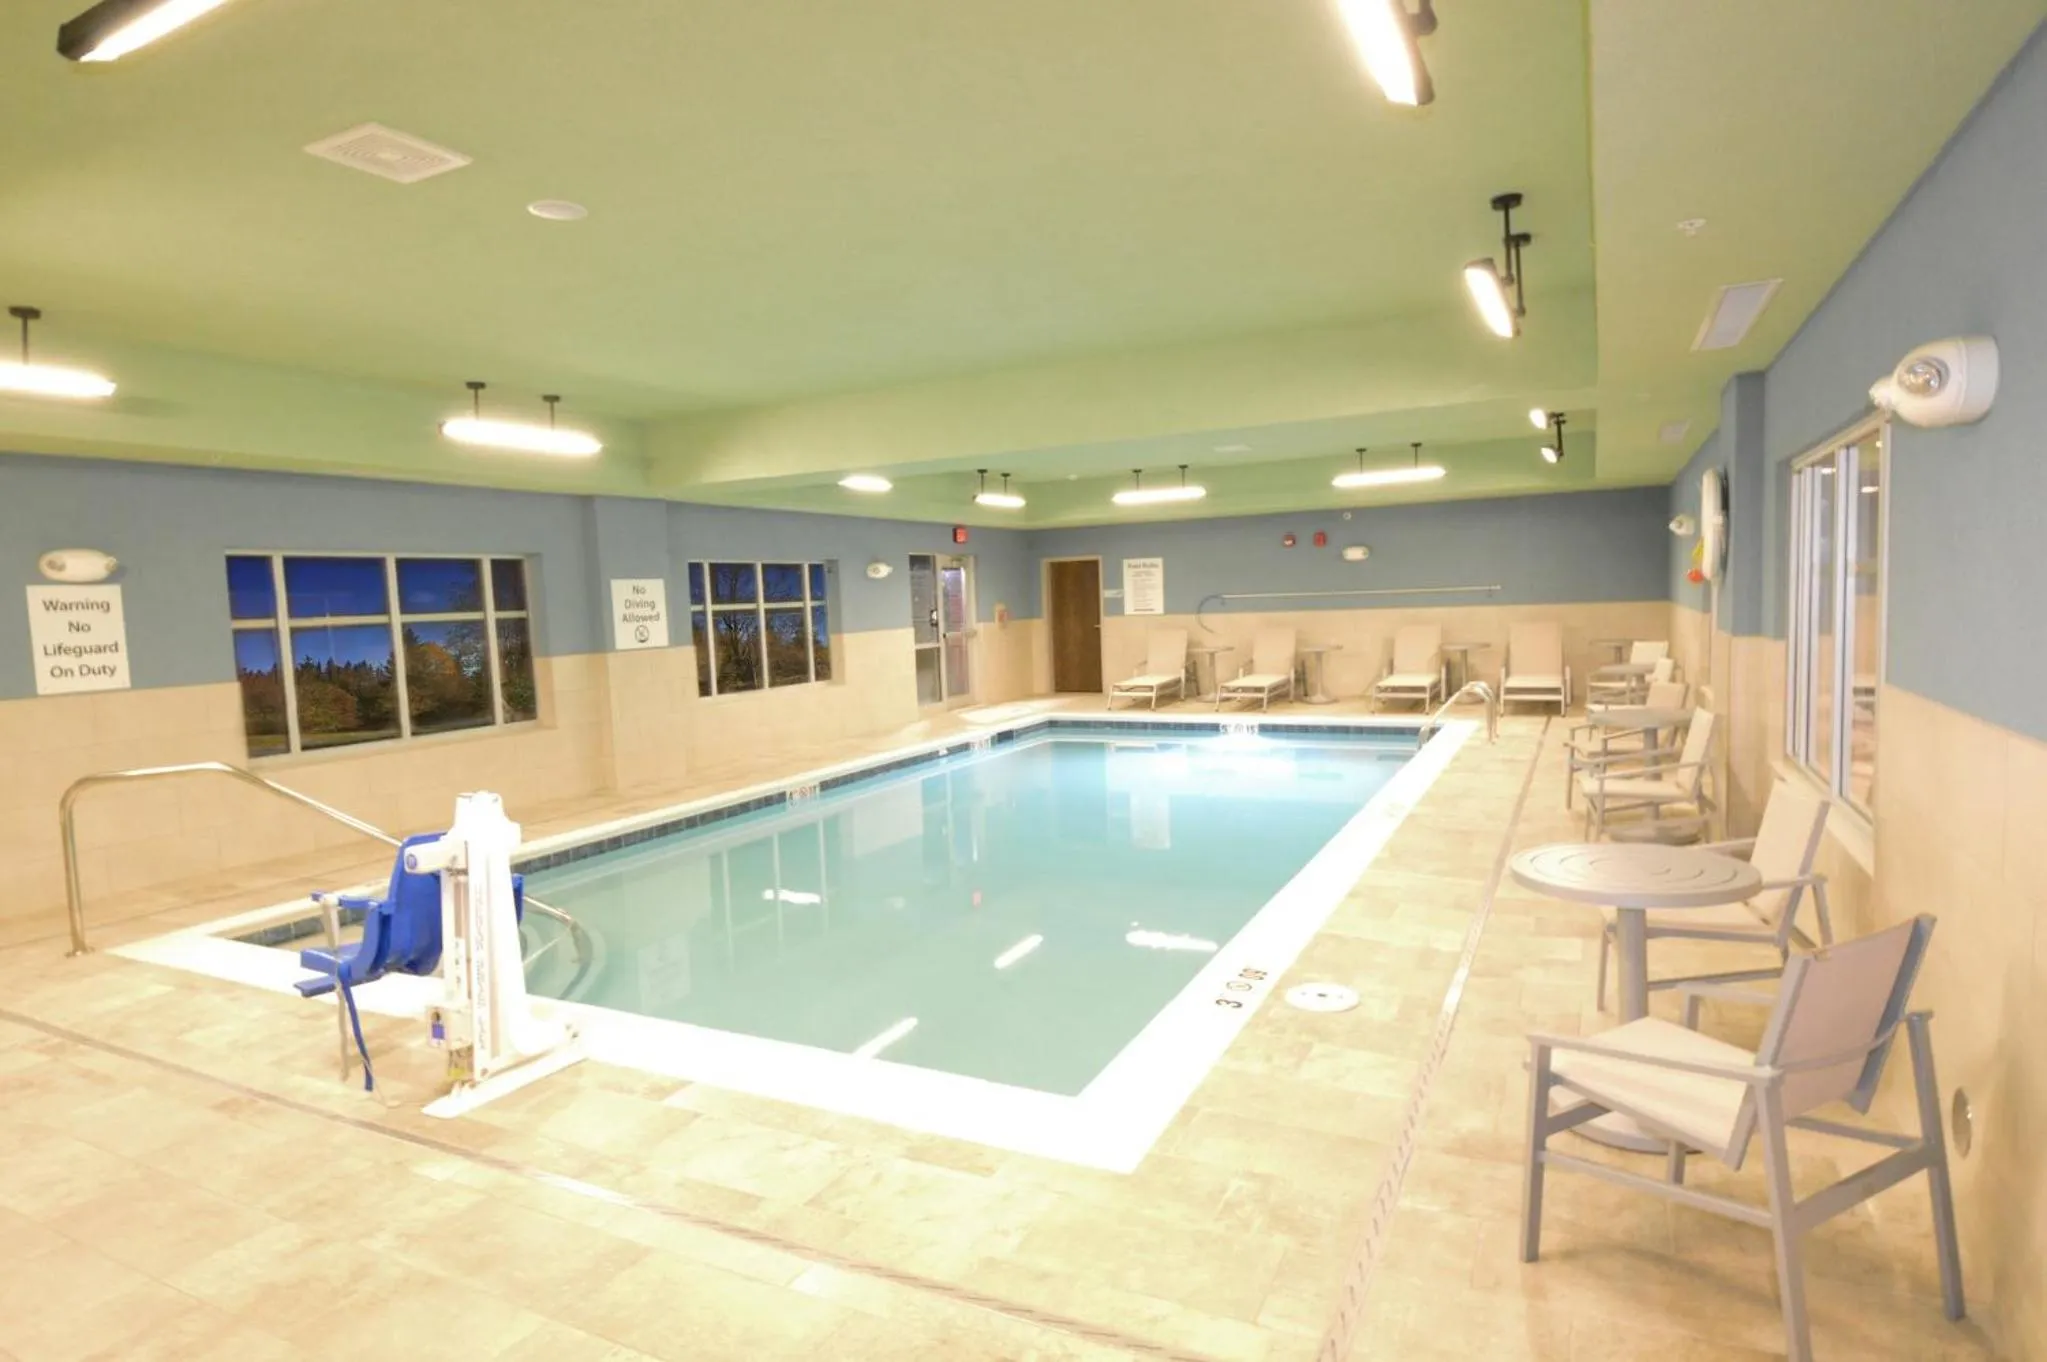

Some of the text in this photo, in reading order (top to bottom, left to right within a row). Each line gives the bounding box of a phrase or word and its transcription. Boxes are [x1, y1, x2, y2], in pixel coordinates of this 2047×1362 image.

[632, 585, 646, 595] No
[42, 599, 110, 613] Warning
[624, 599, 655, 610] Diving
[622, 611, 660, 622] Allowed
[67, 621, 91, 633] No
[43, 641, 119, 658] Lifeguard
[50, 664, 117, 678] On Duty
